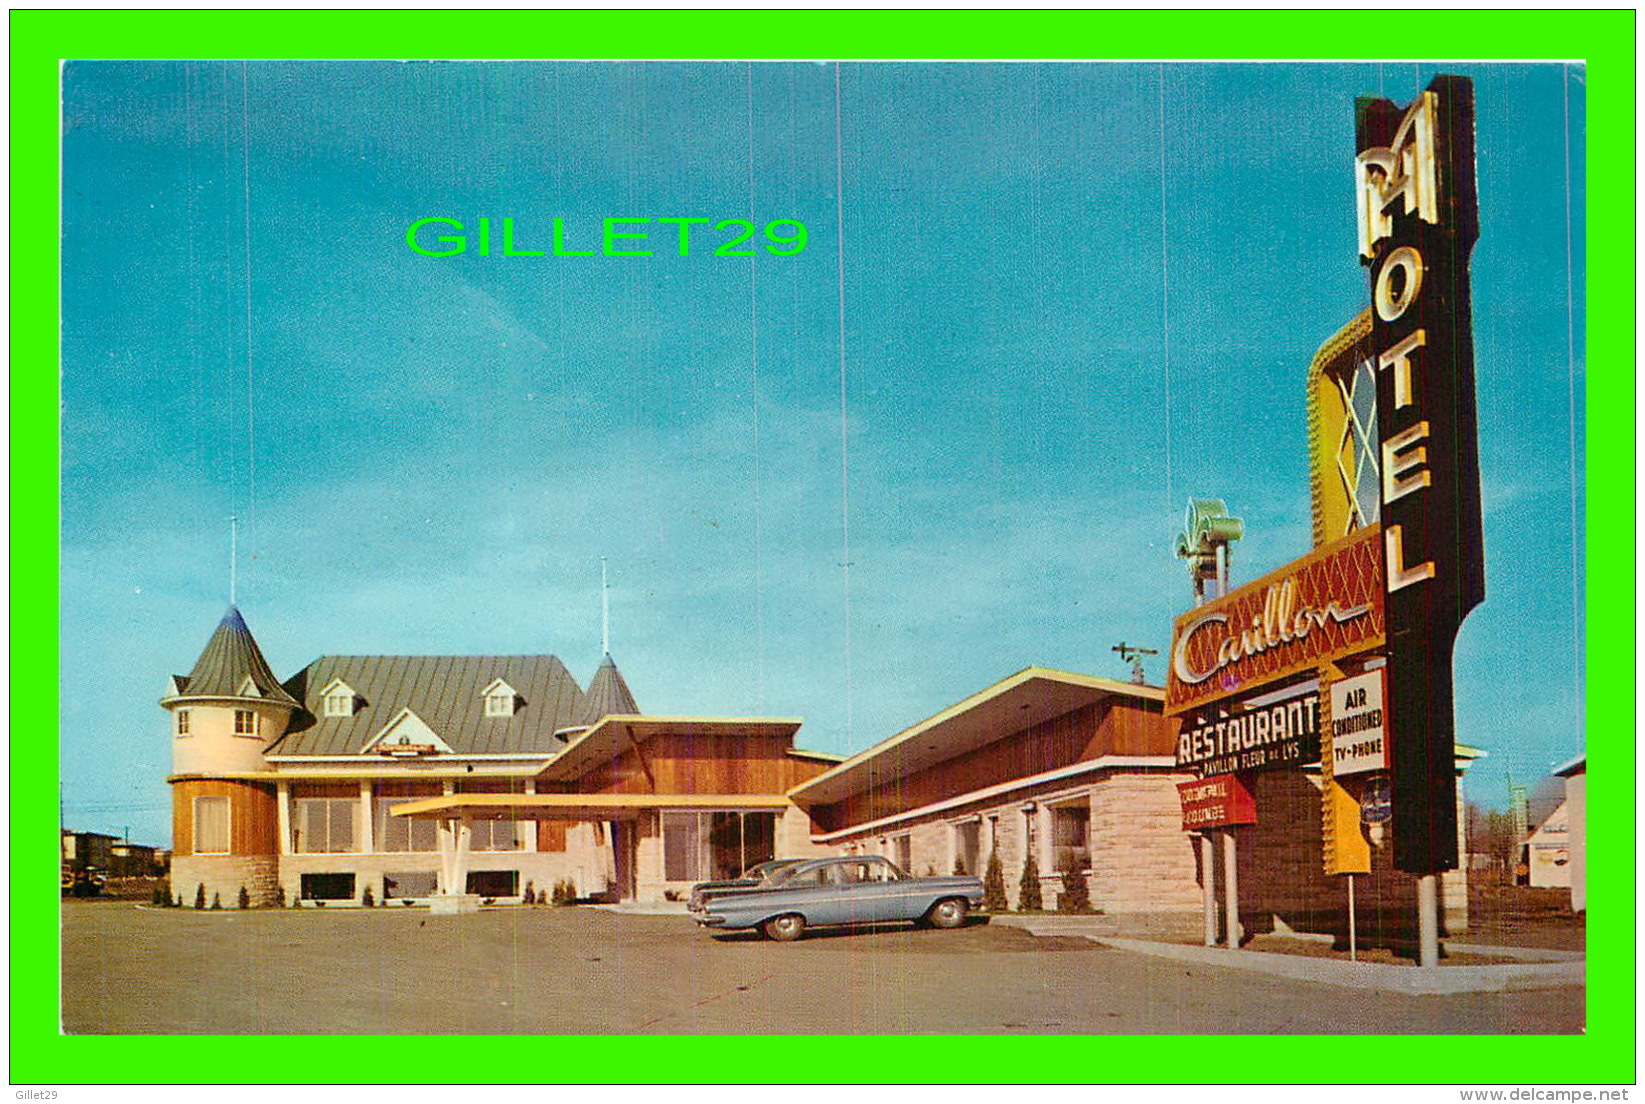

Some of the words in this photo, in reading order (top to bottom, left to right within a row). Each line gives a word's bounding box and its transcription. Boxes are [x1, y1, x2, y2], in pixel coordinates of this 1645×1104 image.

[1355, 90, 1438, 592] MOTEL
[1174, 577, 1375, 684] Carillon
[1345, 688, 1367, 711] AIR
[1178, 696, 1319, 764] RESTAURANT
[1332, 709, 1382, 737] CONDITIONED
[1242, 750, 1265, 769] FLEUR
[1283, 741, 1299, 761] LYS
[1335, 738, 1382, 761] TV-PHONE
